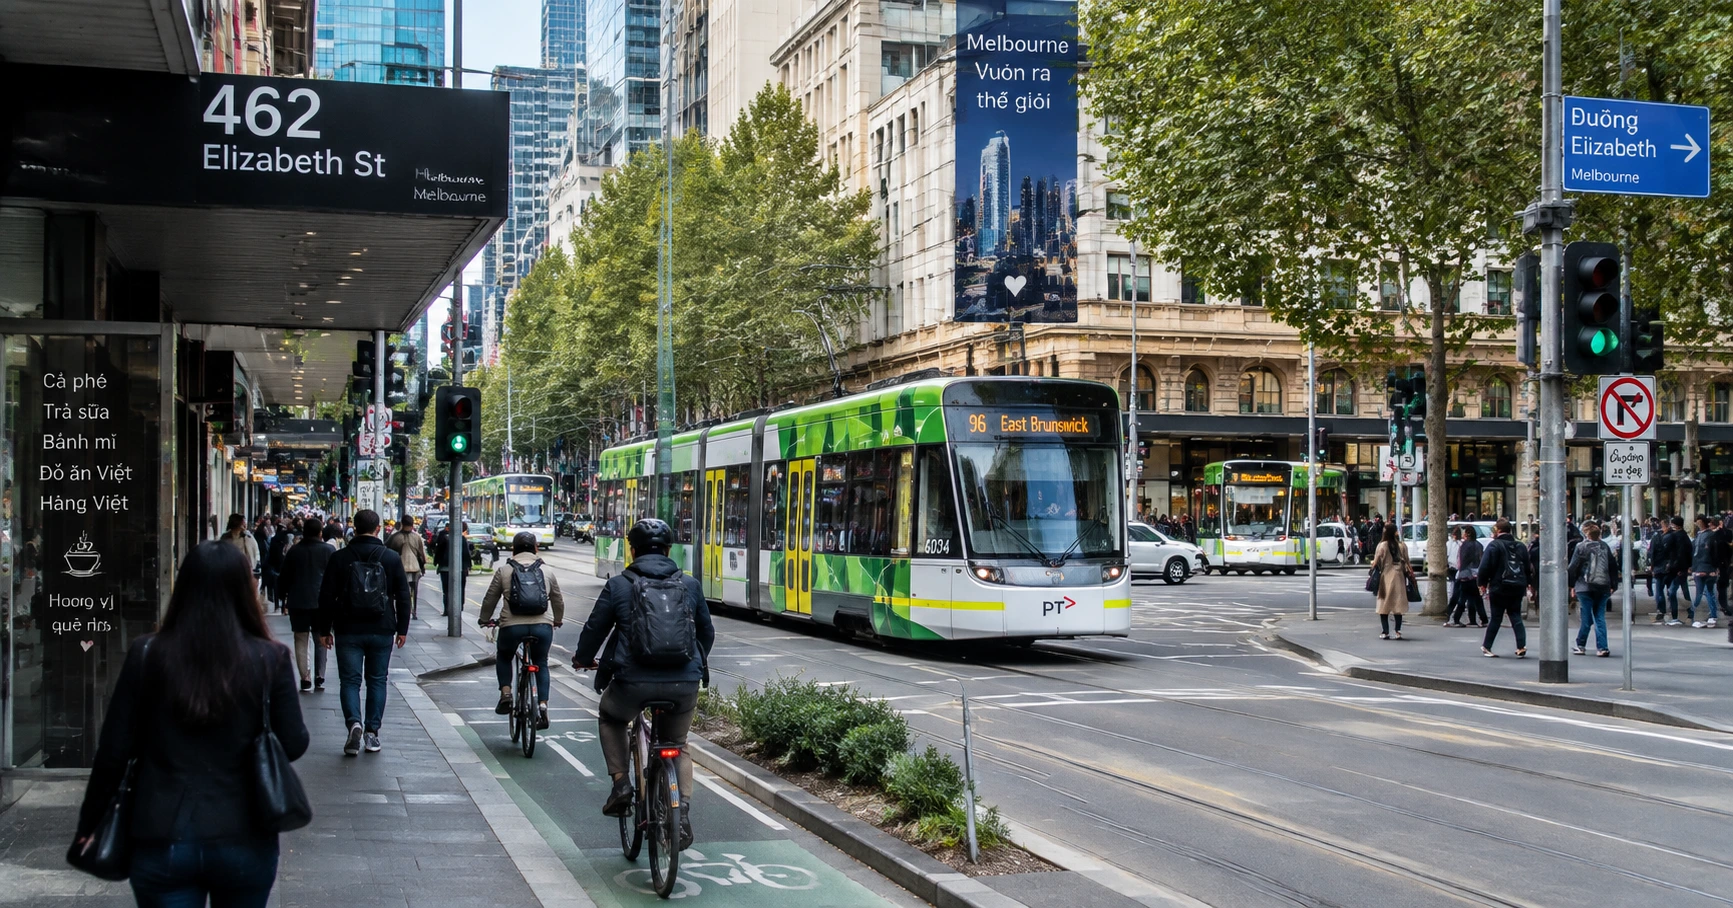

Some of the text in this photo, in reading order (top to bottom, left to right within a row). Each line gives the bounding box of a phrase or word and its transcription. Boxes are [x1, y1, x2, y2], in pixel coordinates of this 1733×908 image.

[967, 33, 1069, 54] Melbourne
[1032, 67, 1051, 82] ra
[203, 84, 321, 139] 462
[203, 143, 343, 175] Elizabeth
[354, 150, 386, 178] St
[1571, 167, 1640, 184] Melbourne
[969, 413, 987, 433] 96
[1001, 414, 1027, 432] East
